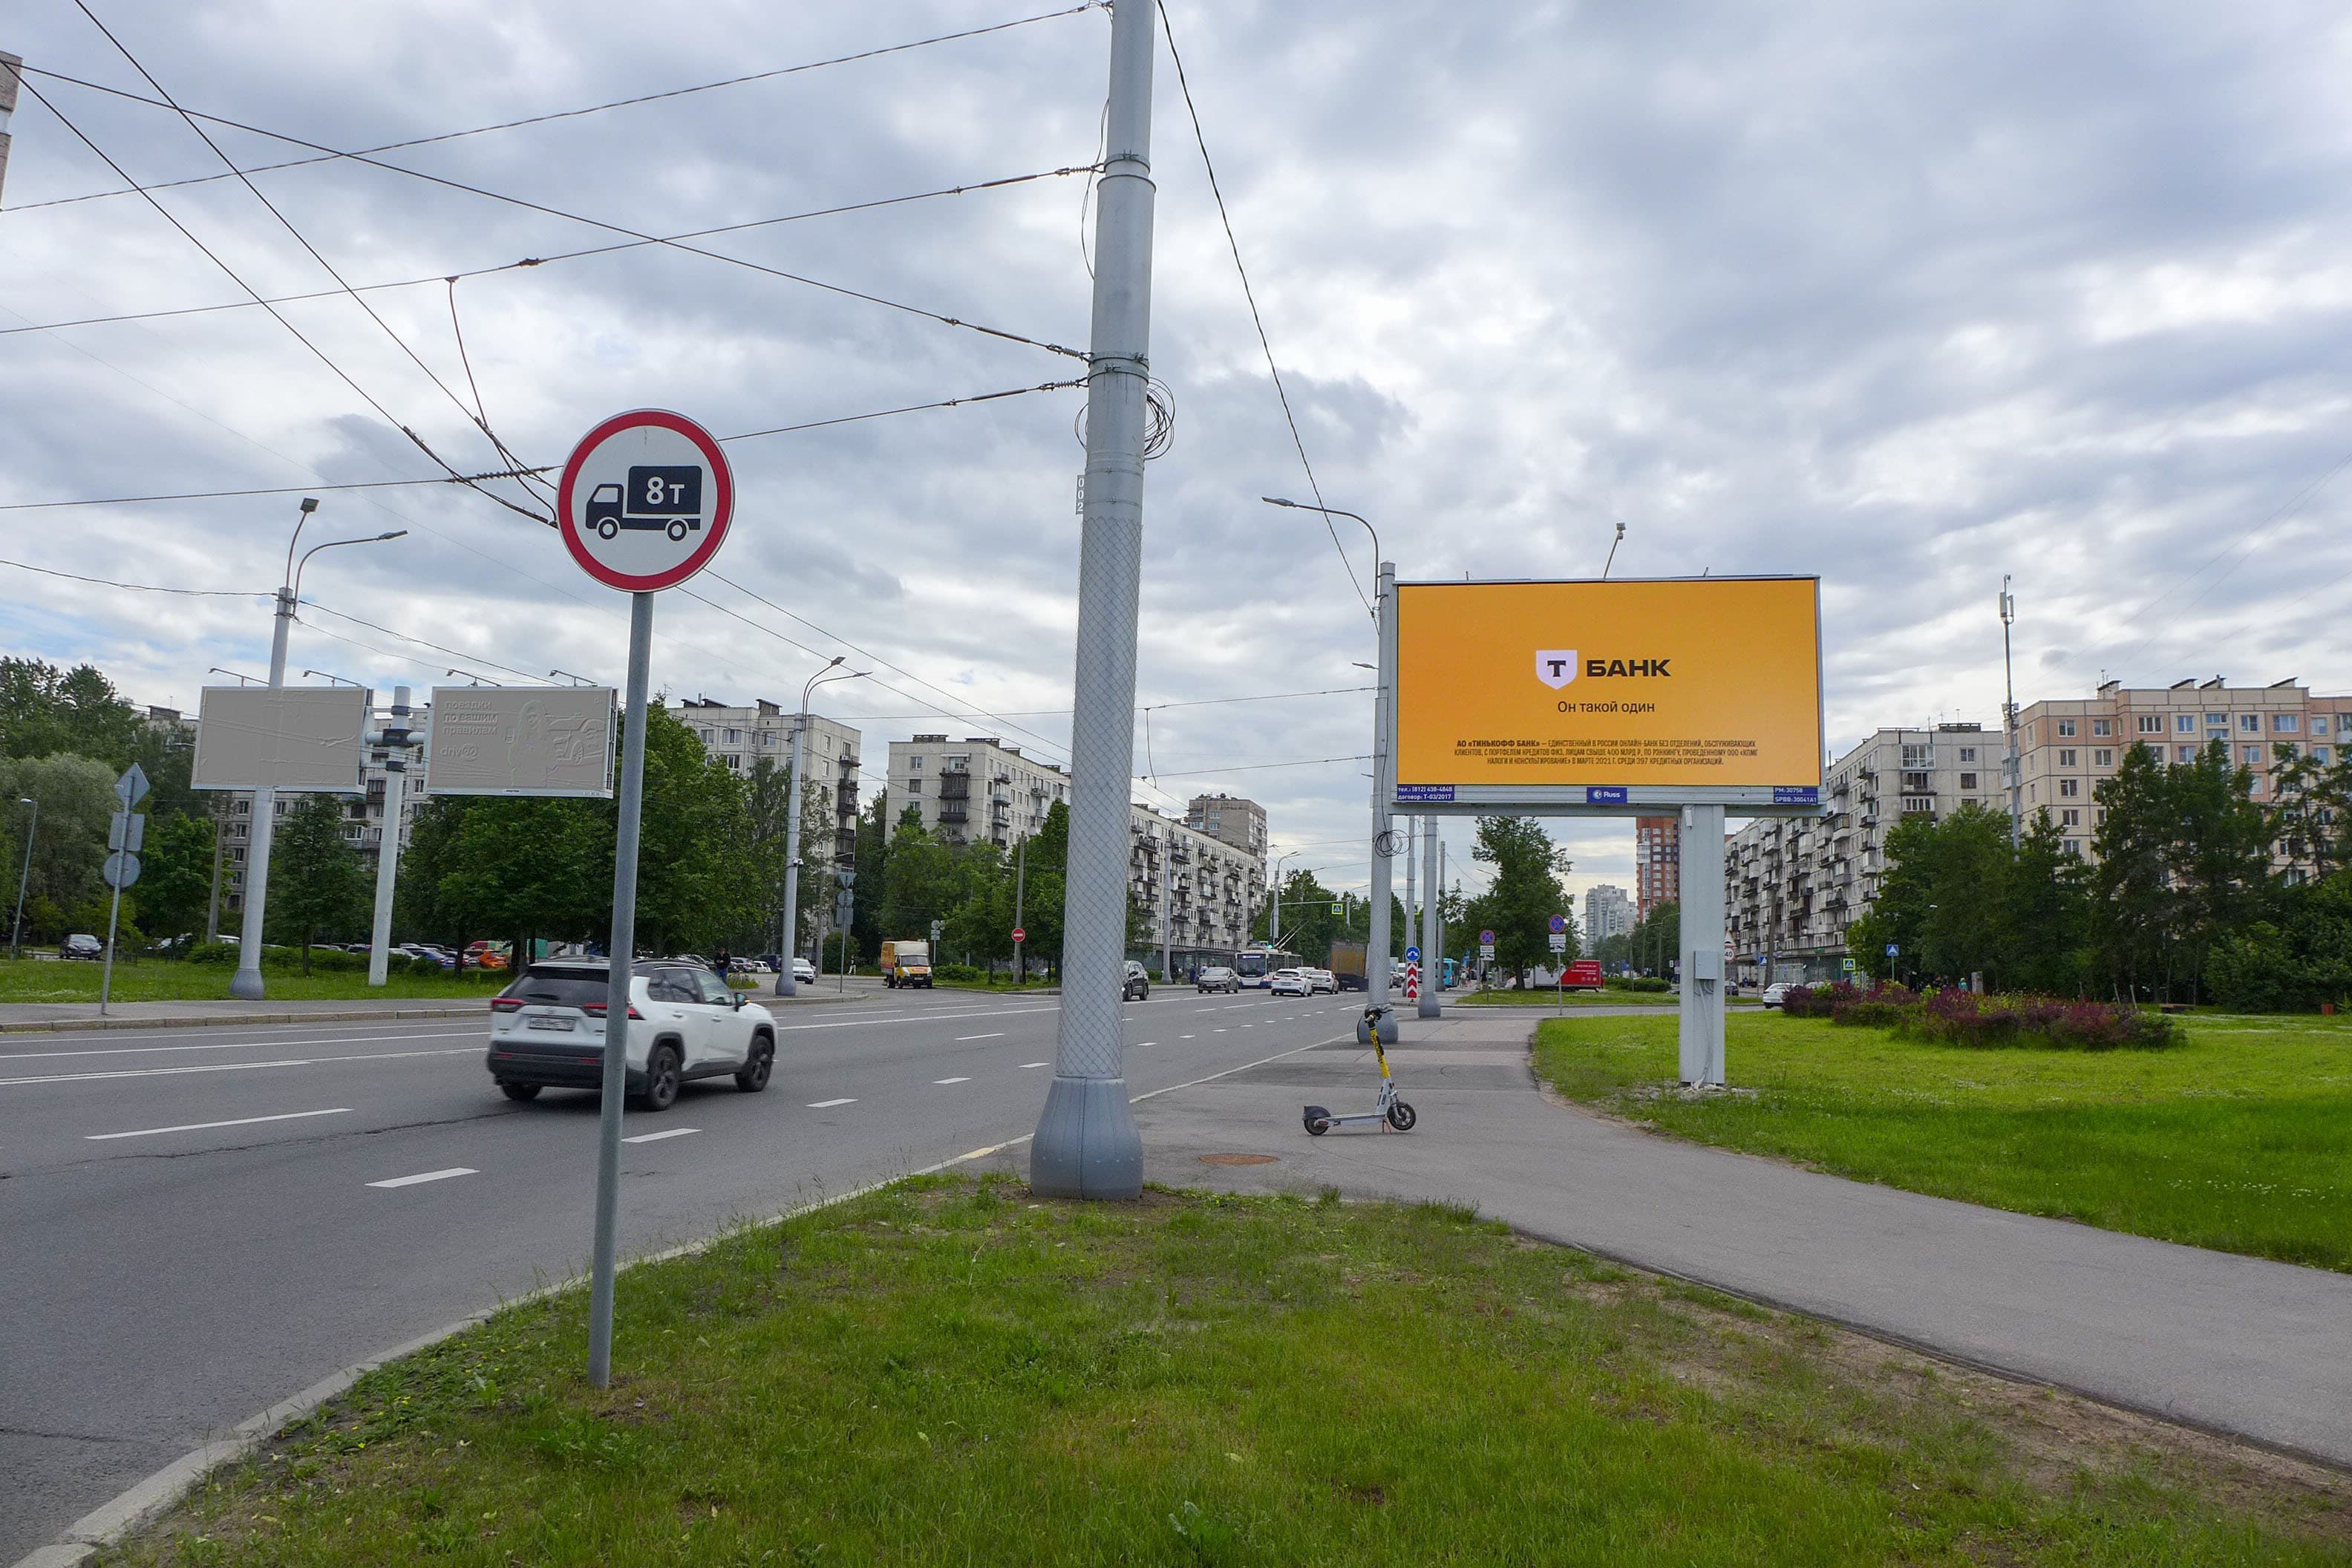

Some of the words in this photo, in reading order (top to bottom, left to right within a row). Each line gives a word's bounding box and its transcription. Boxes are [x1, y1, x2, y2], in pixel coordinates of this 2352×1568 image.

[1587, 659, 1671, 677] БАНК
[1558, 701, 1575, 713] Он
[1580, 701, 1618, 713] такой
[1621, 702, 1655, 714] один
[444, 713, 457, 722] по
[460, 713, 498, 723] вашим
[442, 726, 498, 736] правилам
[1455, 748, 1483, 757] КЛИЕНТОВ,
